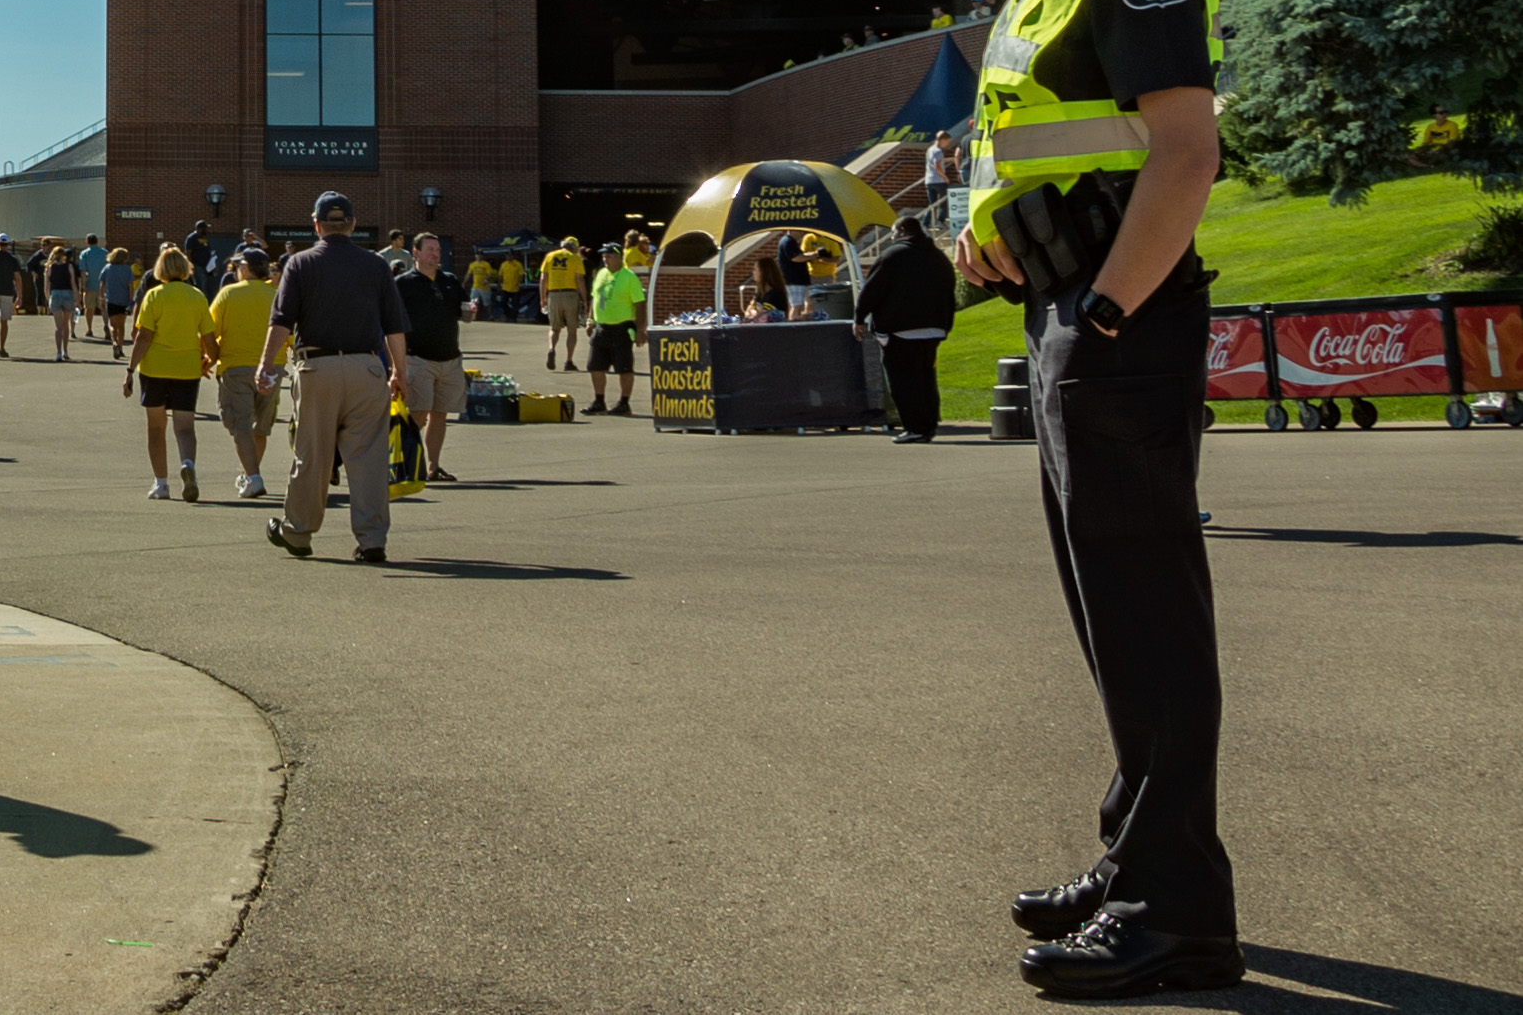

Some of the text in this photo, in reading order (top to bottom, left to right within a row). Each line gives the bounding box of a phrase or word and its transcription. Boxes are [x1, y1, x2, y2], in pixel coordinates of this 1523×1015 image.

[760, 184, 805, 196] Fresh
[750, 194, 817, 208] Roasted
[748, 207, 819, 222] Almonds
[552, 257, 568, 268] M
[660, 337, 700, 362] Fresh
[1308, 323, 1408, 369] Coca-Cola
[653, 365, 712, 391] Roasted
[654, 393, 715, 420] Almonds
